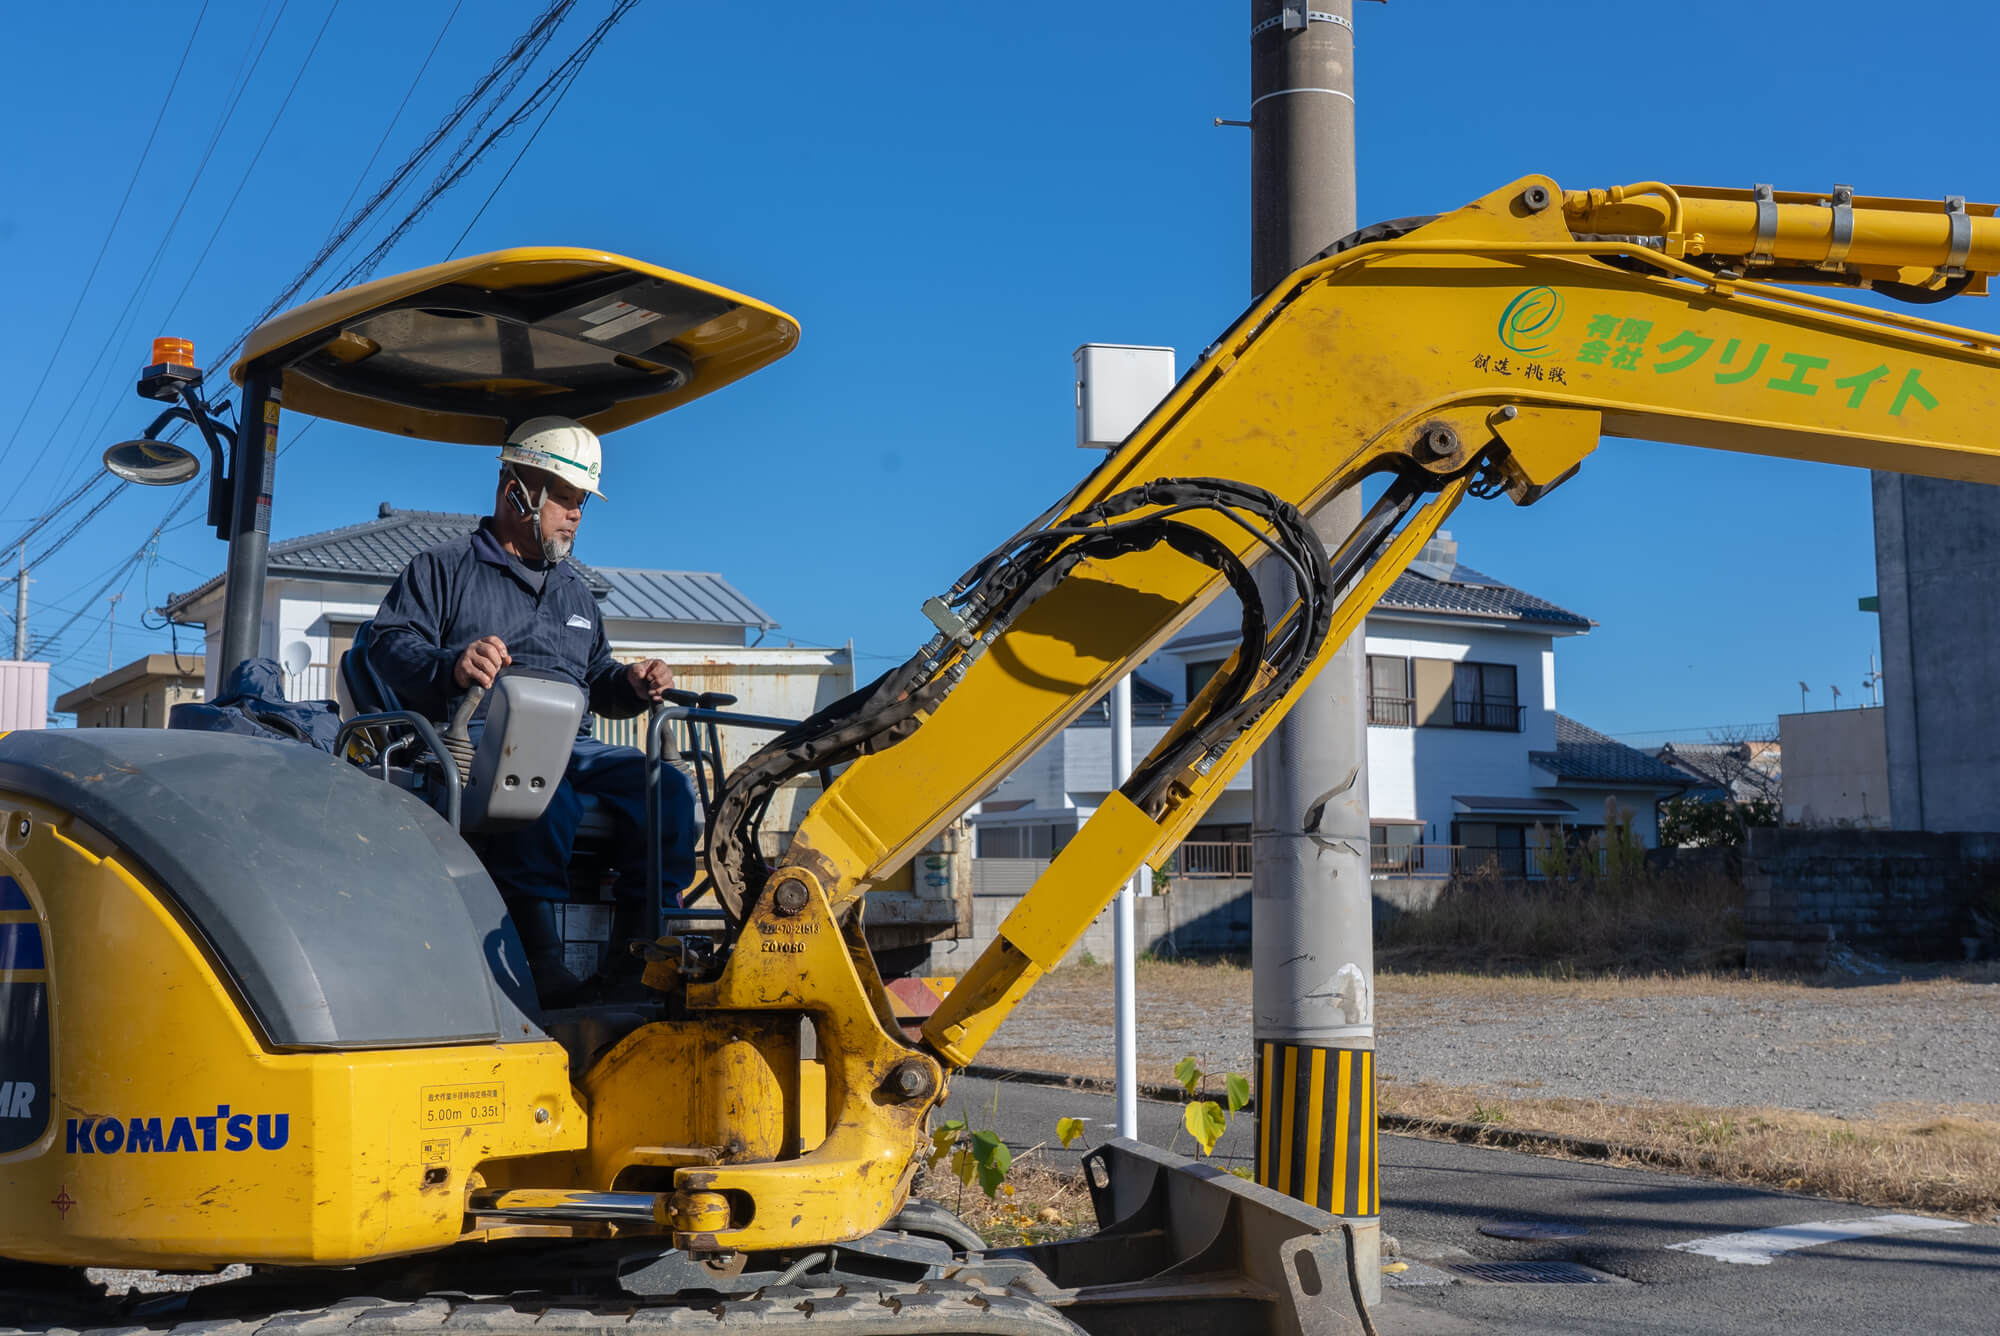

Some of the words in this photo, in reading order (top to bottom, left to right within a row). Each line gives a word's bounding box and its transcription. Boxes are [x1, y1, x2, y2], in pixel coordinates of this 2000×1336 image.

[1586, 314, 1654, 344] 有限
[1576, 340, 1643, 372] 会社
[1653, 330, 1940, 417] クリエイト
[66, 1104, 290, 1154] KOMATSU
[427, 1108, 462, 1122] 5.00m
[471, 1105, 498, 1118] 0.35t
